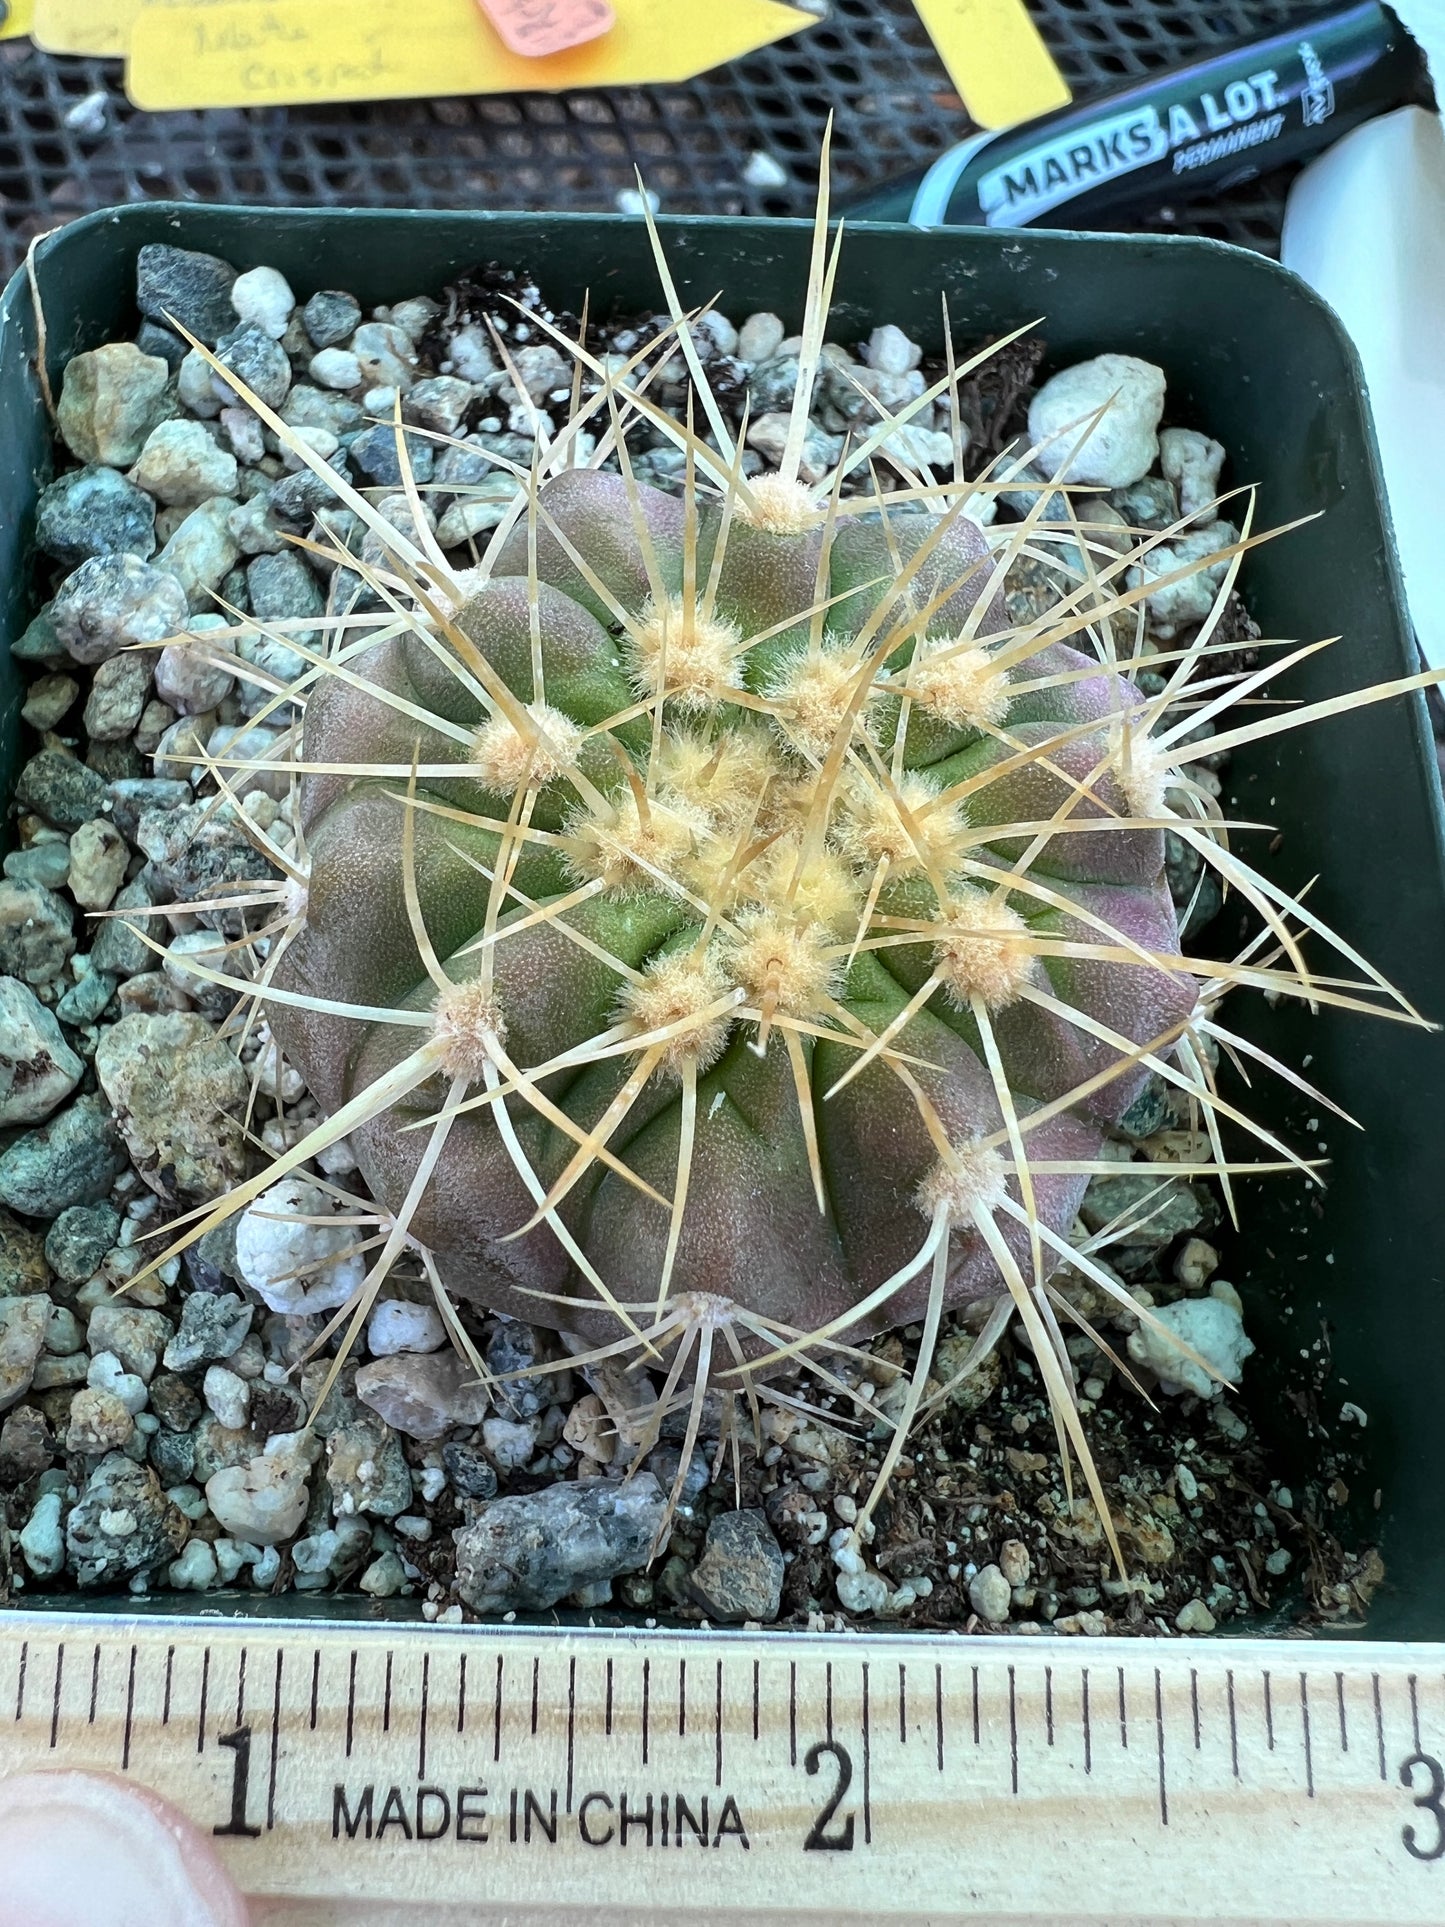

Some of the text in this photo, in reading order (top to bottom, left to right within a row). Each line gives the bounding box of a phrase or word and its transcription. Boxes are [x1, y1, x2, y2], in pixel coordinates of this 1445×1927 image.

[1002, 123, 1152, 203] MARKS
[1167, 104, 1201, 148] A
[213, 1725, 262, 1837] 1
[331, 1783, 750, 1850] MADE IN CHINA
[803, 1740, 855, 1851] 2
[1399, 1753, 1445, 1861] 3
